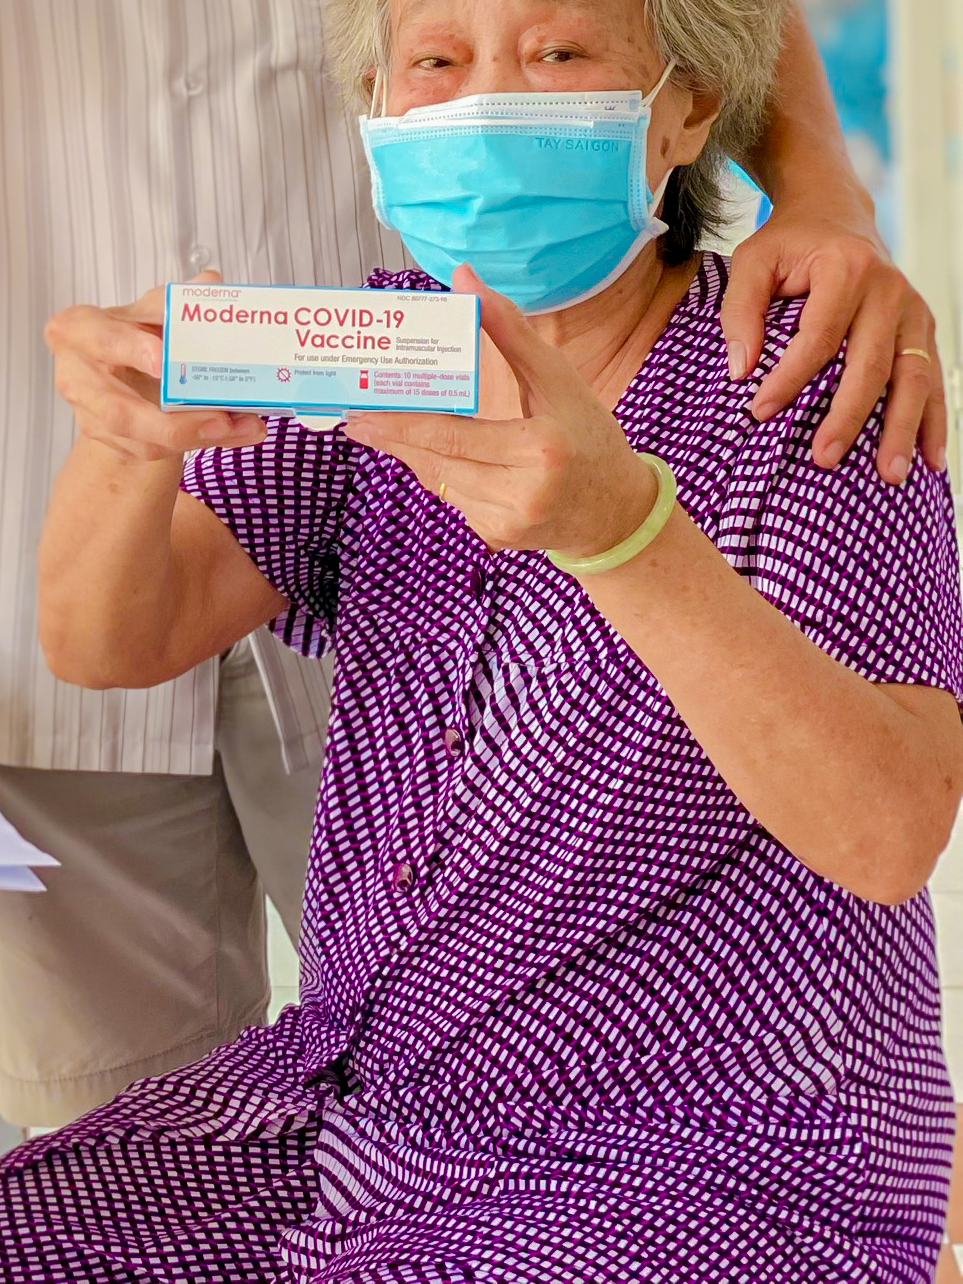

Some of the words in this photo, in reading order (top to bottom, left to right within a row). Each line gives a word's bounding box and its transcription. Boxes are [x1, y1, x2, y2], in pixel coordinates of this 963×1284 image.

[535, 137, 561, 150] TAY
[565, 139, 619, 152] SAIGON
[182, 287, 240, 298] moderna
[181, 303, 288, 325] Moderna
[294, 307, 405, 328] COVID-19
[295, 329, 392, 350] Vaccine
[396, 337, 429, 345] Suspension
[396, 344, 436, 352] Intramuscular
[437, 345, 462, 354] Injection
[294, 353, 305, 361] For
[320, 355, 341, 363] under
[342, 355, 379, 364] Emergency
[380, 356, 393, 364] Use
[394, 356, 439, 365] Authorization
[412, 373, 454, 381] multiple-dose
[458, 390, 471, 398] mL)
